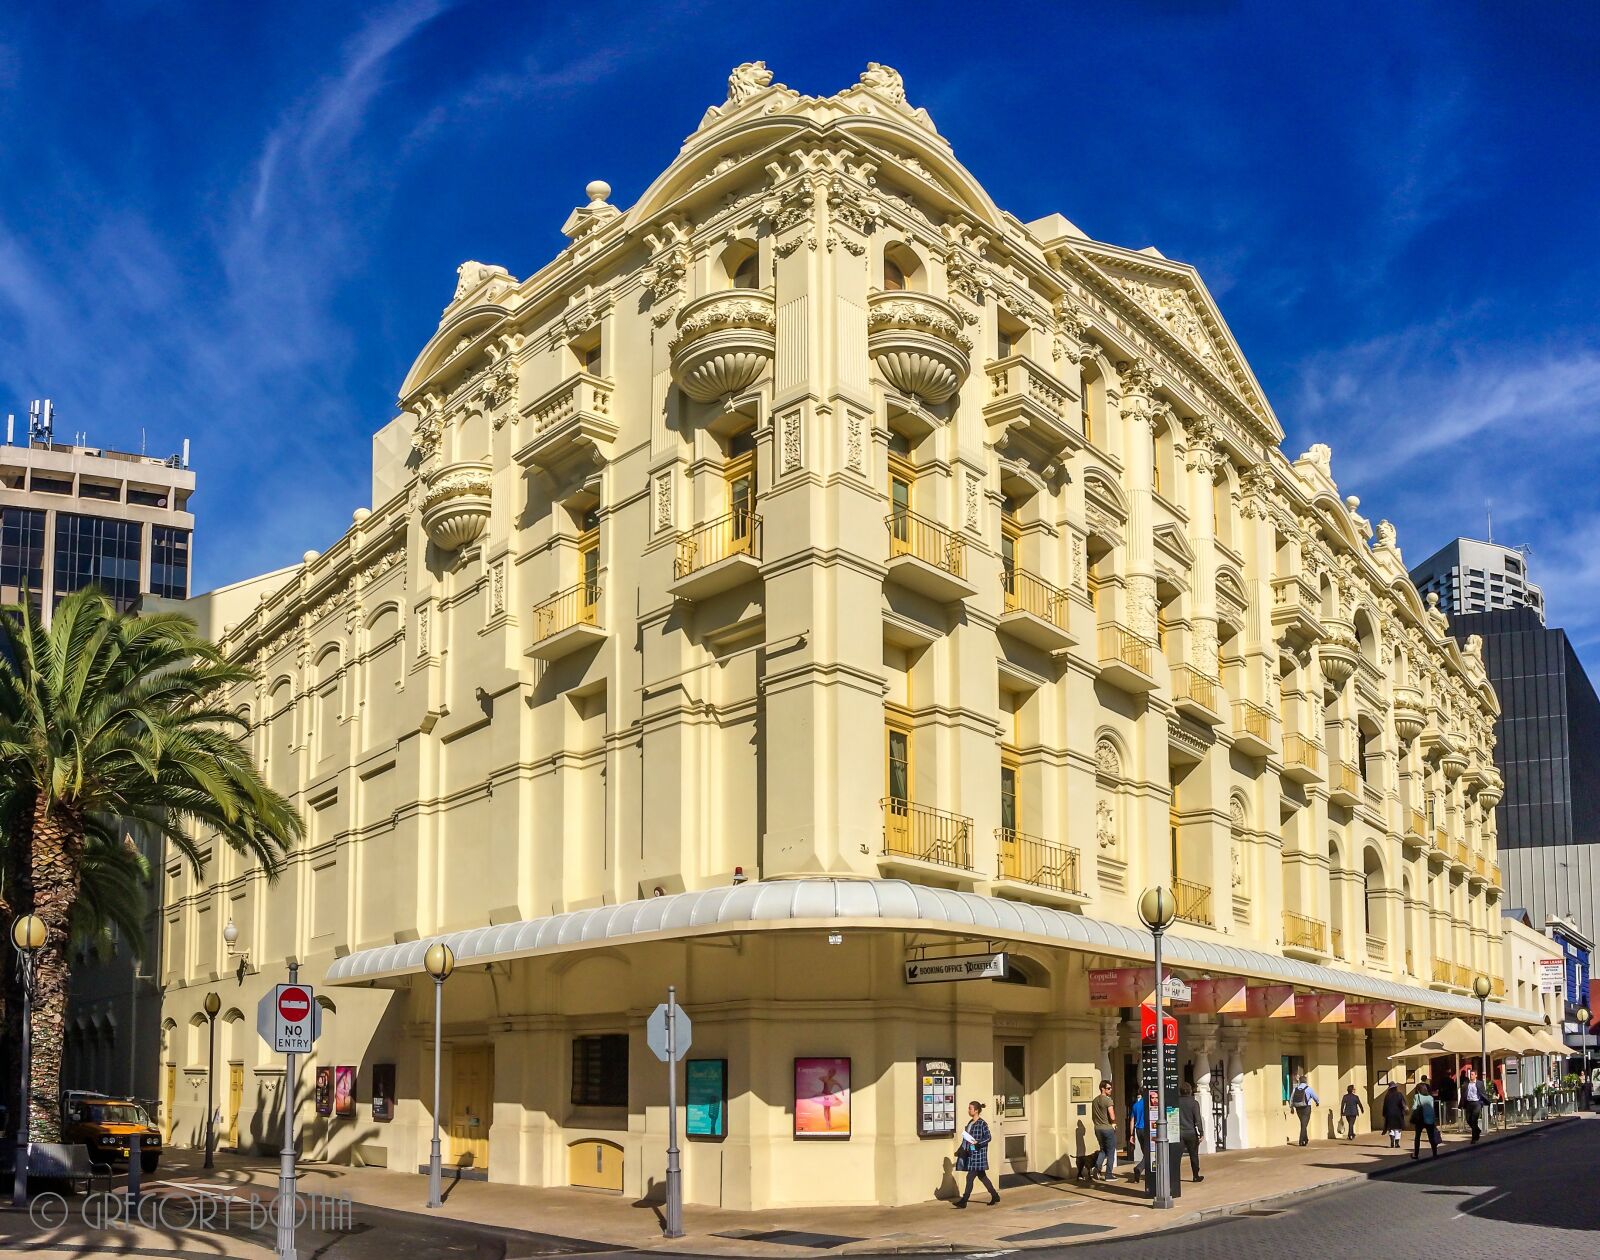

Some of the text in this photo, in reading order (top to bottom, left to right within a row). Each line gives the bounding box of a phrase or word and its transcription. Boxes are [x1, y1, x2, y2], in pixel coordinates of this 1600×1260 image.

[1079, 288, 1107, 318] HIS
[1116, 317, 1196, 394] MAJESTY'S
[920, 965, 944, 975] BOOKING
[944, 964, 963, 974] OFFICE
[285, 1025, 303, 1036] NO
[278, 1038, 309, 1048] ENTRY
